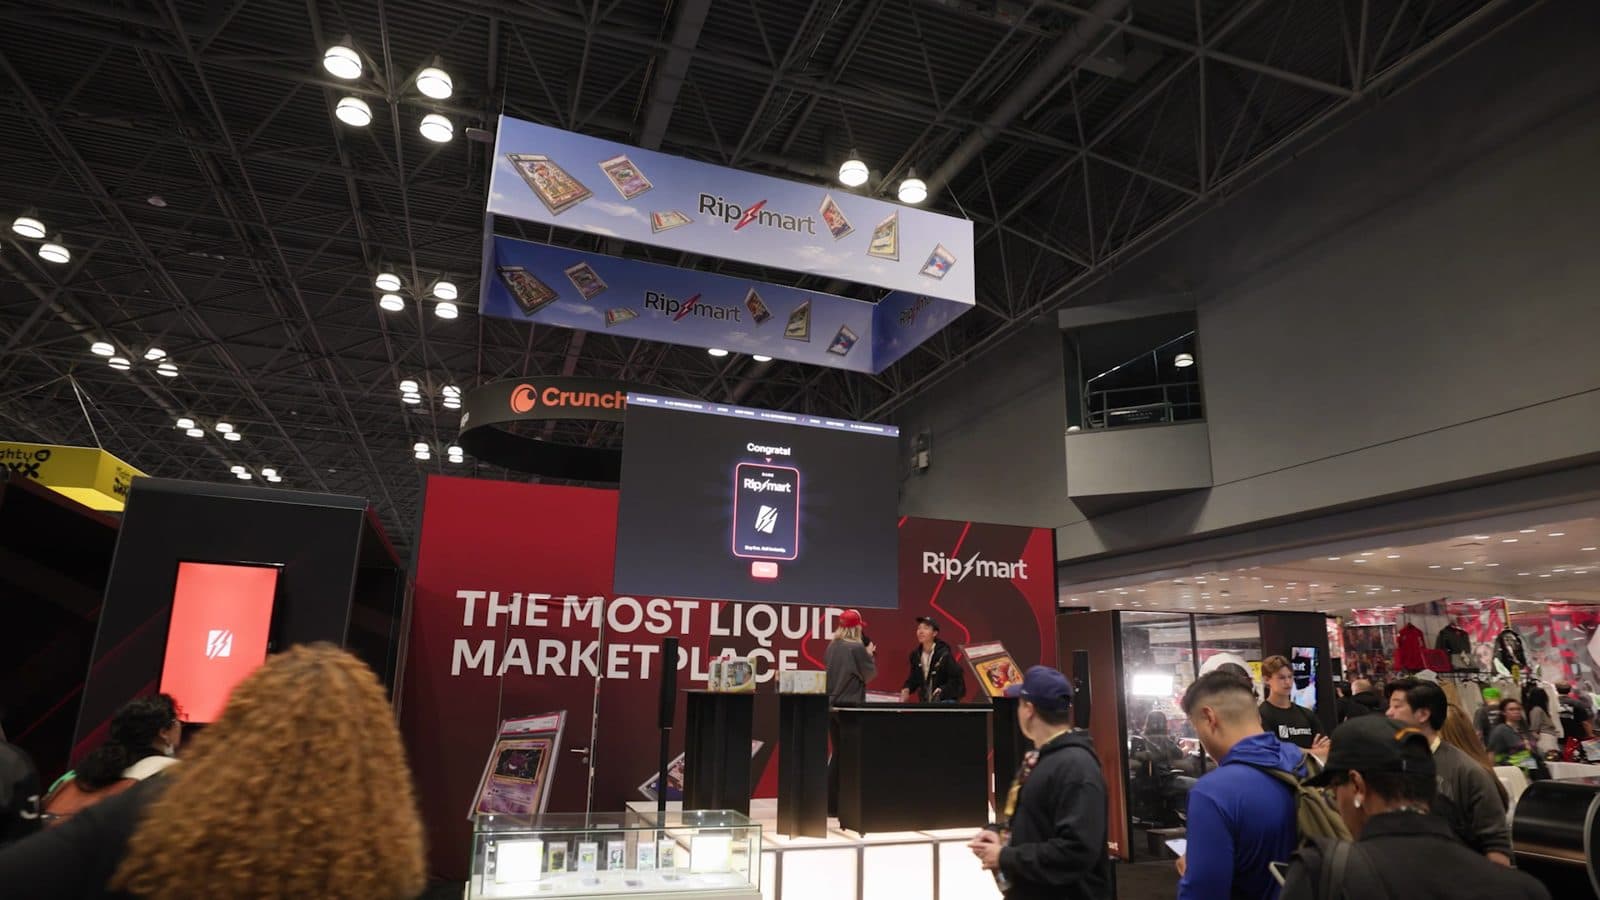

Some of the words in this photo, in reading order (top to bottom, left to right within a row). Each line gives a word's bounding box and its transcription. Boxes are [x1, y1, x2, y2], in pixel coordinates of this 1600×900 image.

[746, 442, 792, 456] Congrats!
[456, 590, 551, 627] THE
[561, 595, 699, 634] MOST
[710, 602, 862, 647] LIQUID
